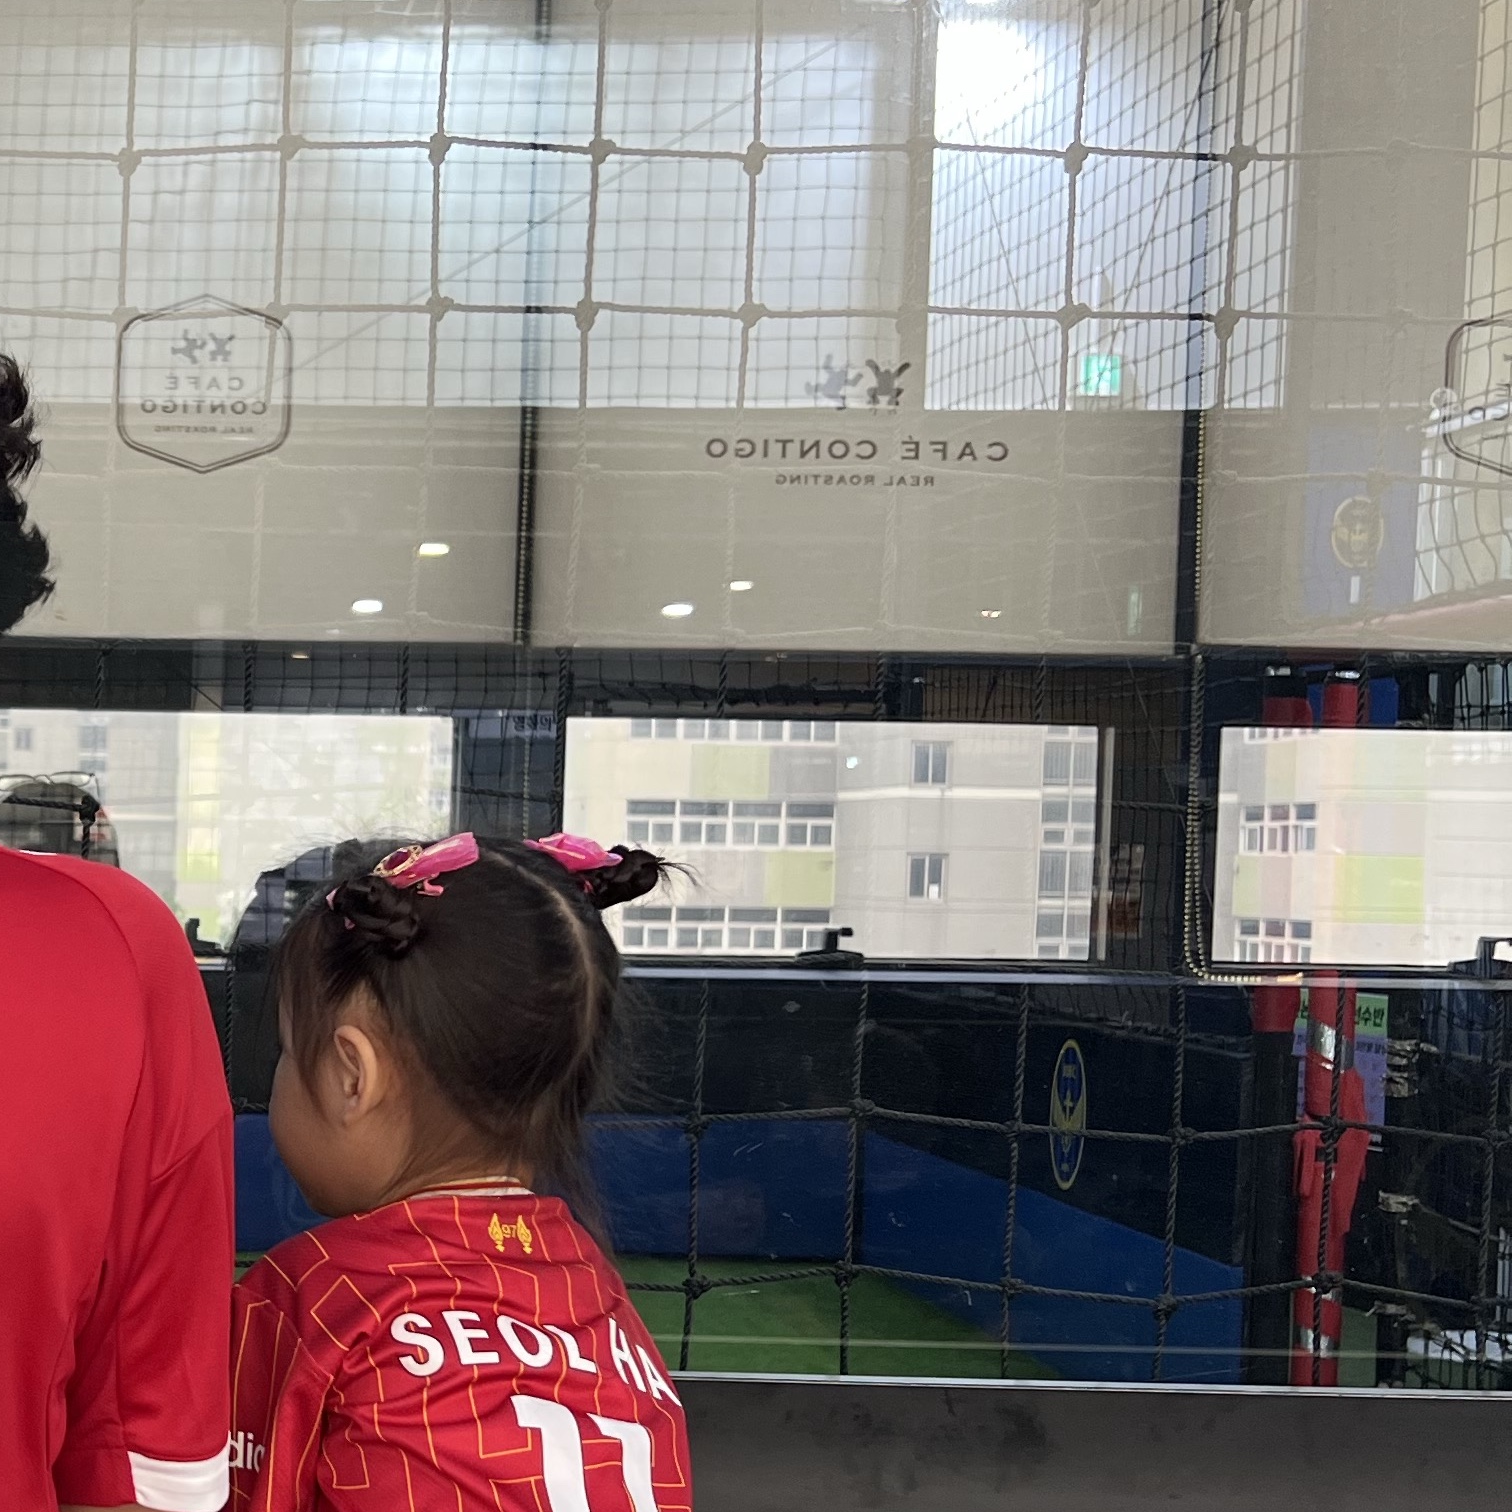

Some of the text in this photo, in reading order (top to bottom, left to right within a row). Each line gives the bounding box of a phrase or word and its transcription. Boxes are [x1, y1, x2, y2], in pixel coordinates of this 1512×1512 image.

[501, 1224, 517, 1238] 97
[390, 1310, 683, 1407] SEOL HA
